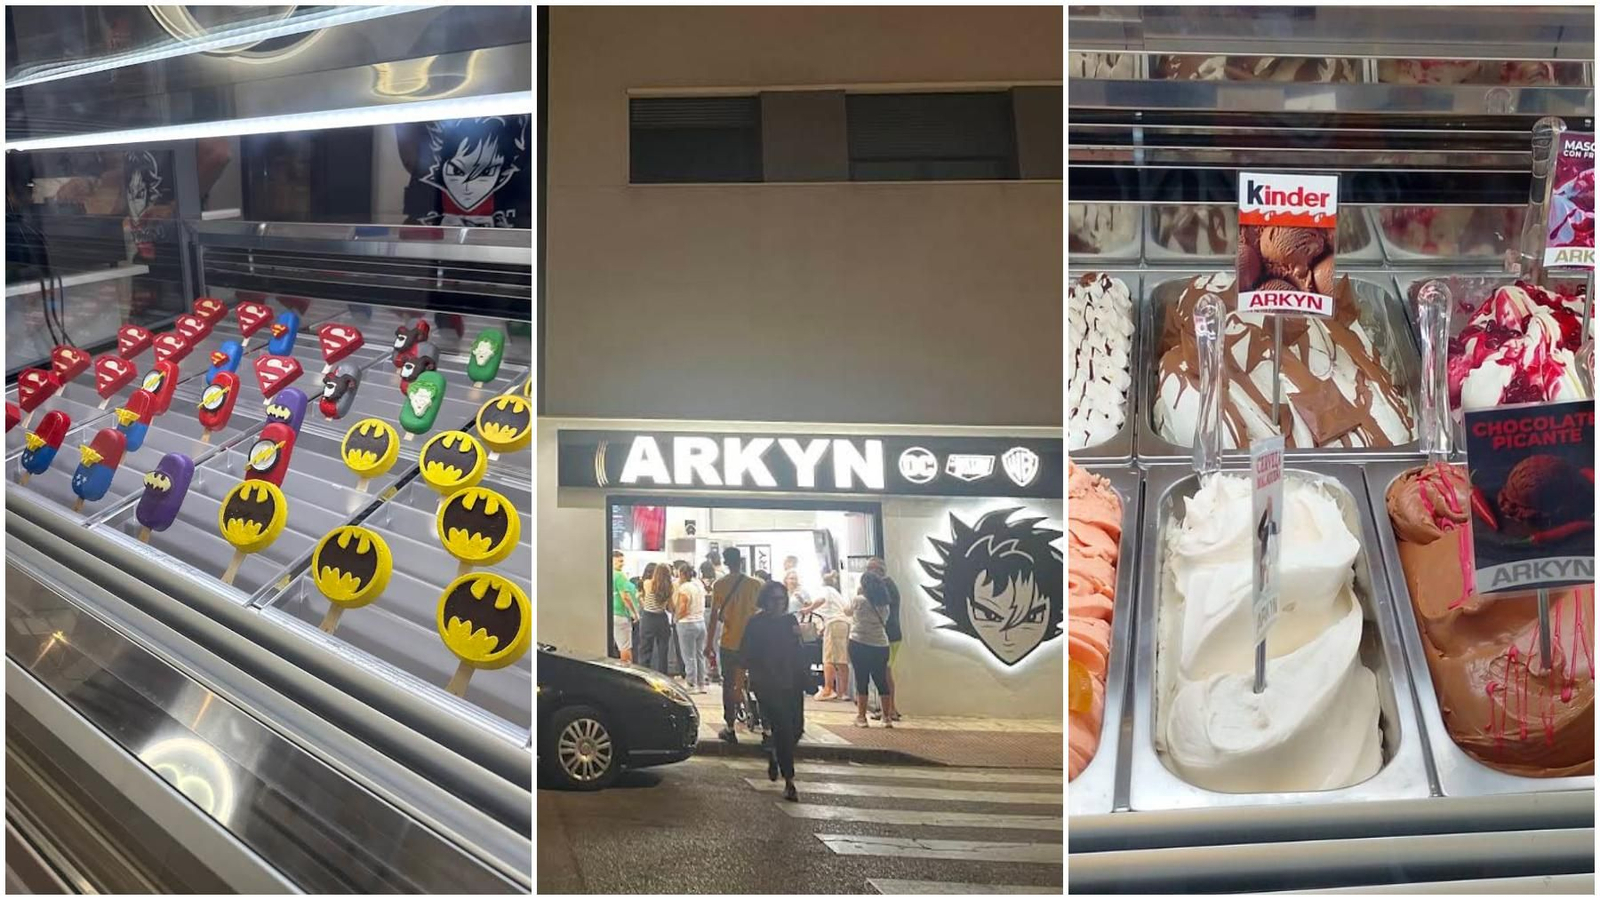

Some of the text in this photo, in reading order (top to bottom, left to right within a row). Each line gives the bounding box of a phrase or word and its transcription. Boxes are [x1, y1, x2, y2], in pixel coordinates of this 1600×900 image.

[1563, 150, 1582, 158] CON
[1249, 293, 1323, 310] ARKYN
[1493, 428, 1582, 450] PICANTE
[620, 435, 885, 489] ARKYN
[1491, 559, 1595, 587] ARKYN
